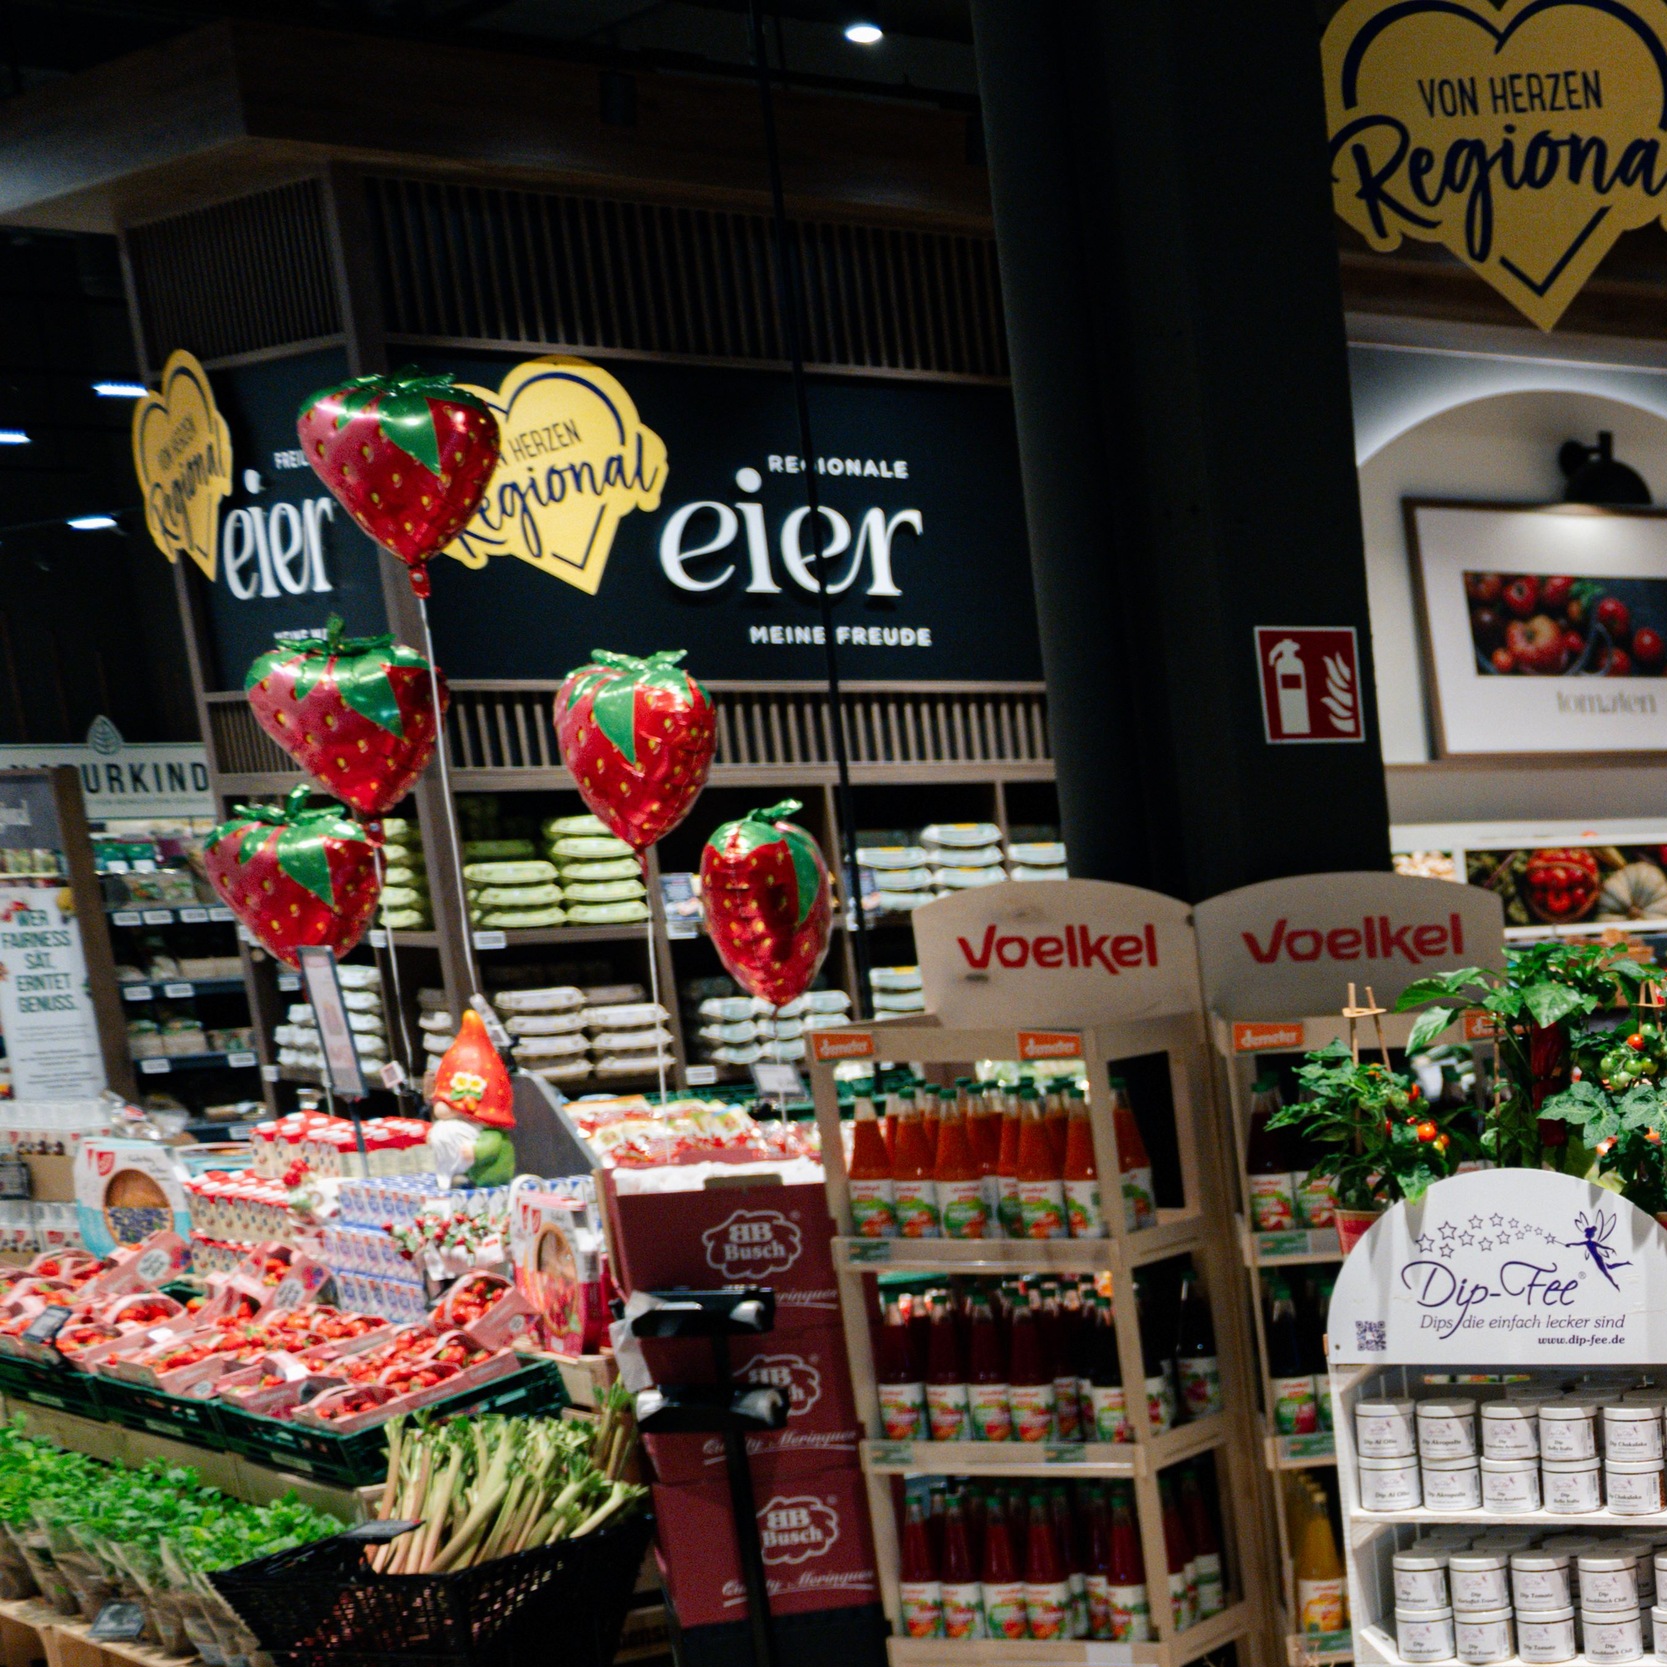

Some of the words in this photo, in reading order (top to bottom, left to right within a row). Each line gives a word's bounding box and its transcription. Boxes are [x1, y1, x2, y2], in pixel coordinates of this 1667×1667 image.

[1418, 77, 1478, 119] VON
[1493, 70, 1603, 117] HERZEN
[510, 420, 582, 465] HERZEN
[768, 455, 909, 479] REIONALE
[659, 467, 923, 597] eier
[750, 626, 826, 646] MEINE
[836, 626, 932, 647] FREUDE
[30, 762, 210, 795] URKIND
[956, 923, 1158, 975] Voelkel
[1241, 913, 1465, 966] Voelkel
[724, 1242, 786, 1263] Busch
[1420, 1313, 1453, 1332] Dips
[1462, 1313, 1485, 1329] die
[1489, 1313, 1541, 1331] einfach
[1545, 1313, 1591, 1329] lecker
[1593, 1313, 1625, 1329] sind
[1537, 1333, 1626, 1347] www.dip-fee.de
[761, 1526, 822, 1546] Busch
